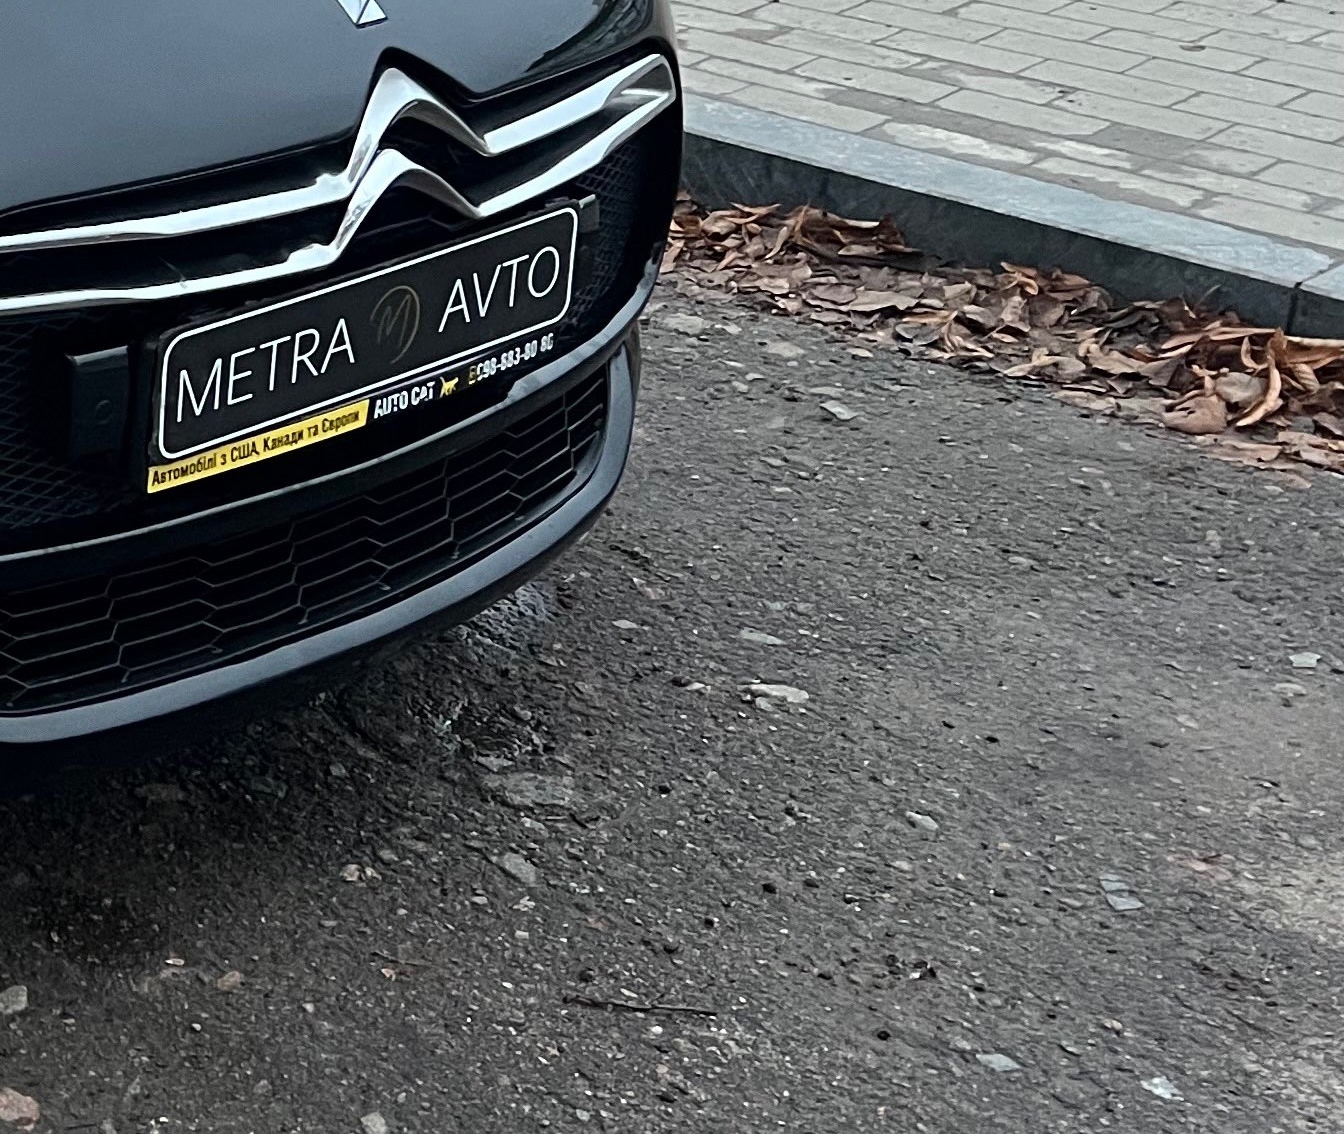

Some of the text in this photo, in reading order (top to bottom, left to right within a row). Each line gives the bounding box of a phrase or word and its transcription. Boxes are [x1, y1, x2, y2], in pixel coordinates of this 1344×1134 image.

[176, 317, 355, 423] METRA
[437, 245, 561, 333] AVTO
[373, 390, 408, 419] AUTO
[151, 453, 217, 487] Автомобілі
[220, 453, 227, 466] з
[262, 430, 304, 453] Канади
[307, 425, 320, 439] та
